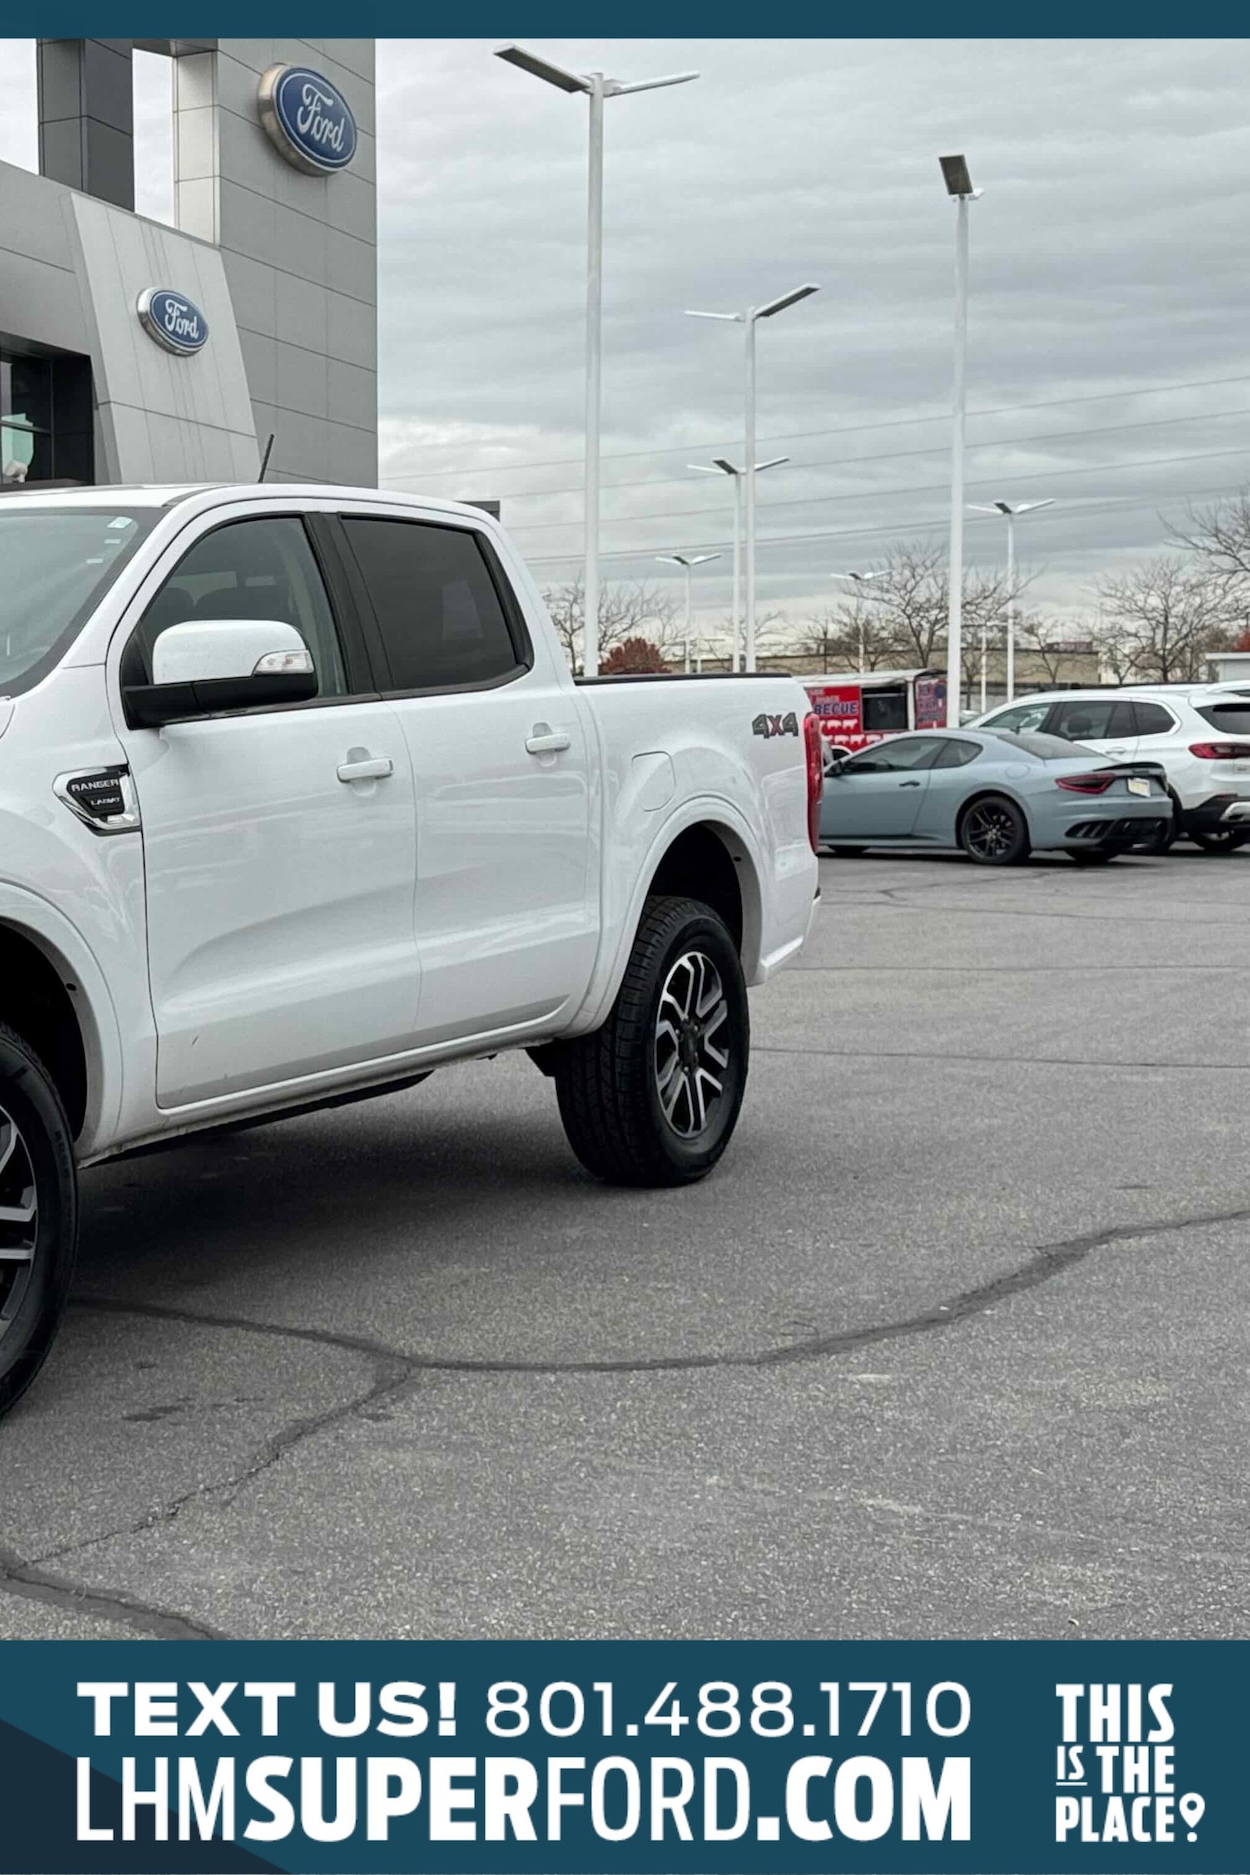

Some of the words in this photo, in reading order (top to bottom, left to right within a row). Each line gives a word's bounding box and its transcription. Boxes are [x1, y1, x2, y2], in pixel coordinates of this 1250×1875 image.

[297, 84, 344, 152] Ford
[165, 299, 199, 339] Ford
[71, 779, 119, 792] RANGER
